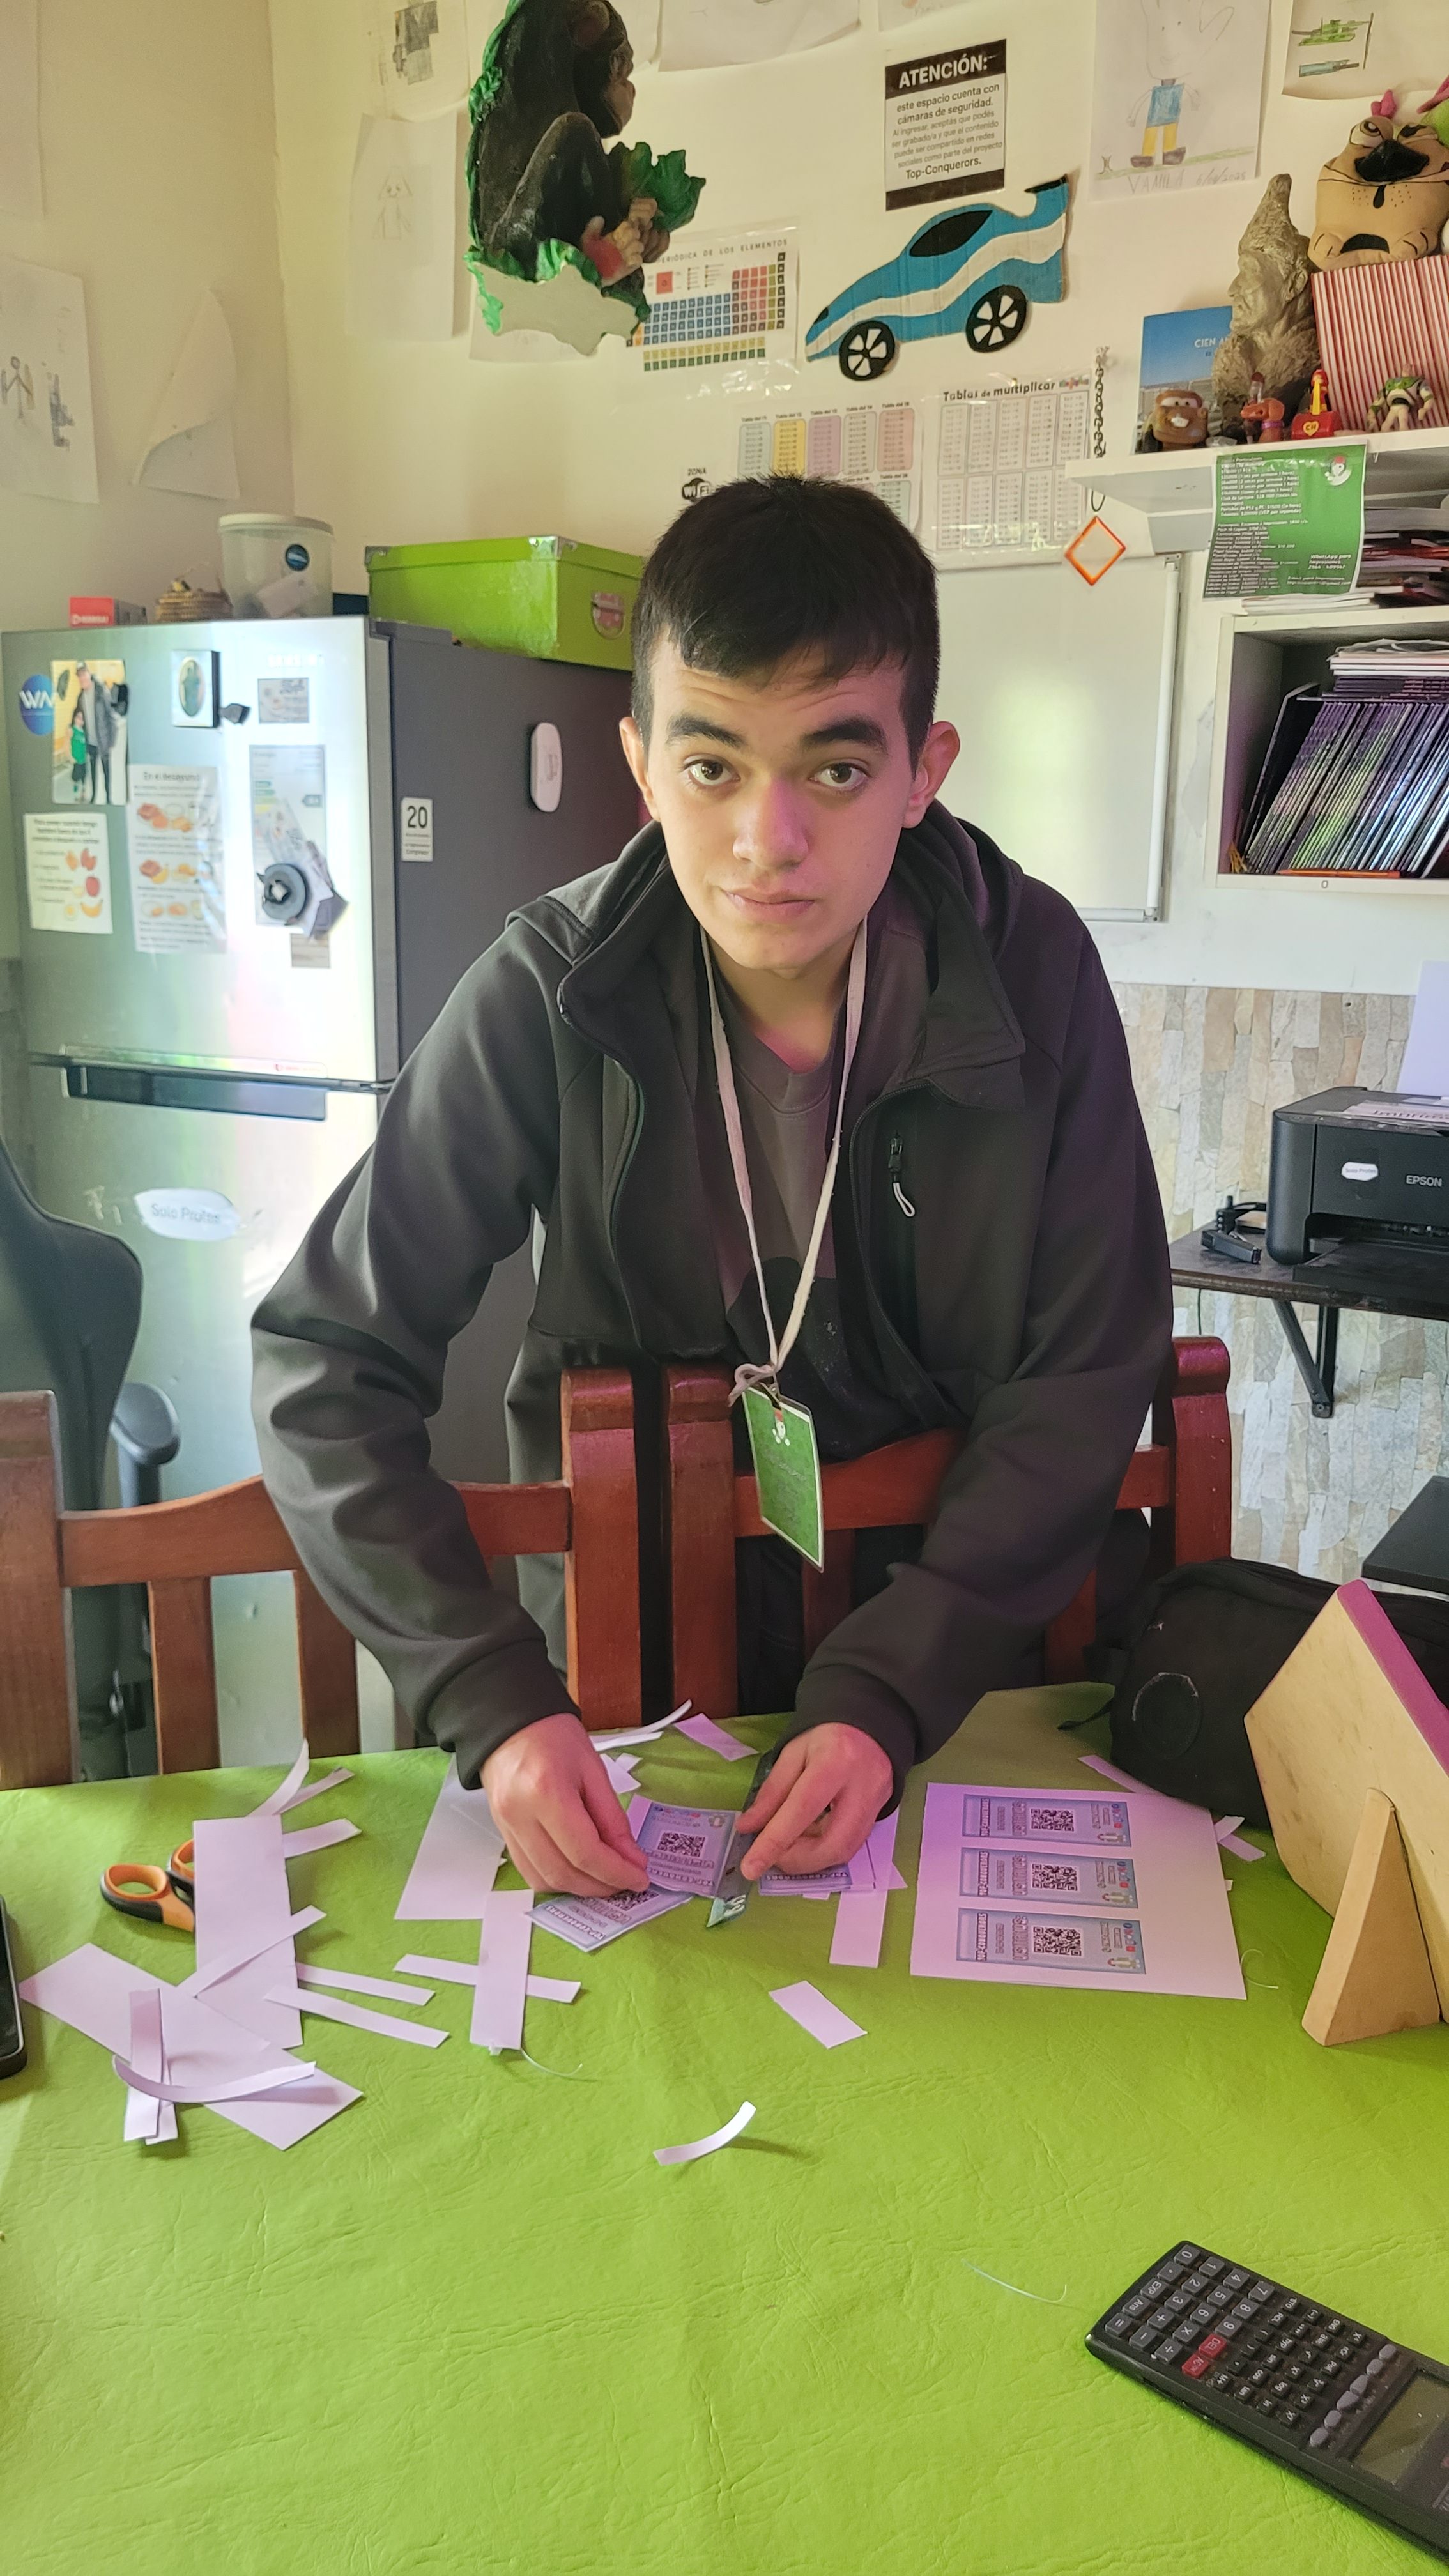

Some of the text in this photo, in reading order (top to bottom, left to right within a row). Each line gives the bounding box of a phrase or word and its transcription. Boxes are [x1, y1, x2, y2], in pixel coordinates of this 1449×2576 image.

[899, 53, 988, 89] ATENCIÓN:
[896, 84, 1000, 112] este espacio cuenta con
[897, 97, 993, 125] cámaras de seguridad.
[931, 117, 957, 130] aceptás
[958, 114, 971, 123] que
[972, 110, 995, 122] podés
[903, 132, 937, 148] grabado/a
[938, 132, 942, 141] y
[944, 129, 956, 139] que
[958, 126, 963, 134] el
[965, 120, 999, 134] contenido
[894, 148, 914, 159] puede
[926, 137, 965, 153] compartido
[976, 132, 995, 142] redes
[898, 141, 1003, 168] sociales como parte del proyecto
[906, 157, 982, 180] Top-Conquerors.
[719, 247, 734, 255] LOS
[740, 239, 788, 252] ELEMENTOS
[1194, 337, 1216, 348] CIEN
[943, 389, 978, 402] Tablas
[993, 381, 1055, 396] multiplicar
[408, 806, 427, 828] 20
[1406, 1175, 1443, 1187] EPSON
[1181, 2250, 1192, 2258] 0
[1189, 2279, 1200, 2287] 2
[1231, 2274, 1241, 2282] 4
[1148, 2281, 1162, 2295] EXP
[1215, 2291, 1226, 2299] 5
[1257, 2287, 1268, 2296] 7
[1129, 2299, 1144, 2311] Ans
[1198, 2309, 1209, 2317] 6
[1223, 2321, 1235, 2329] 9
[1208, 2338, 1221, 2350] DEL
